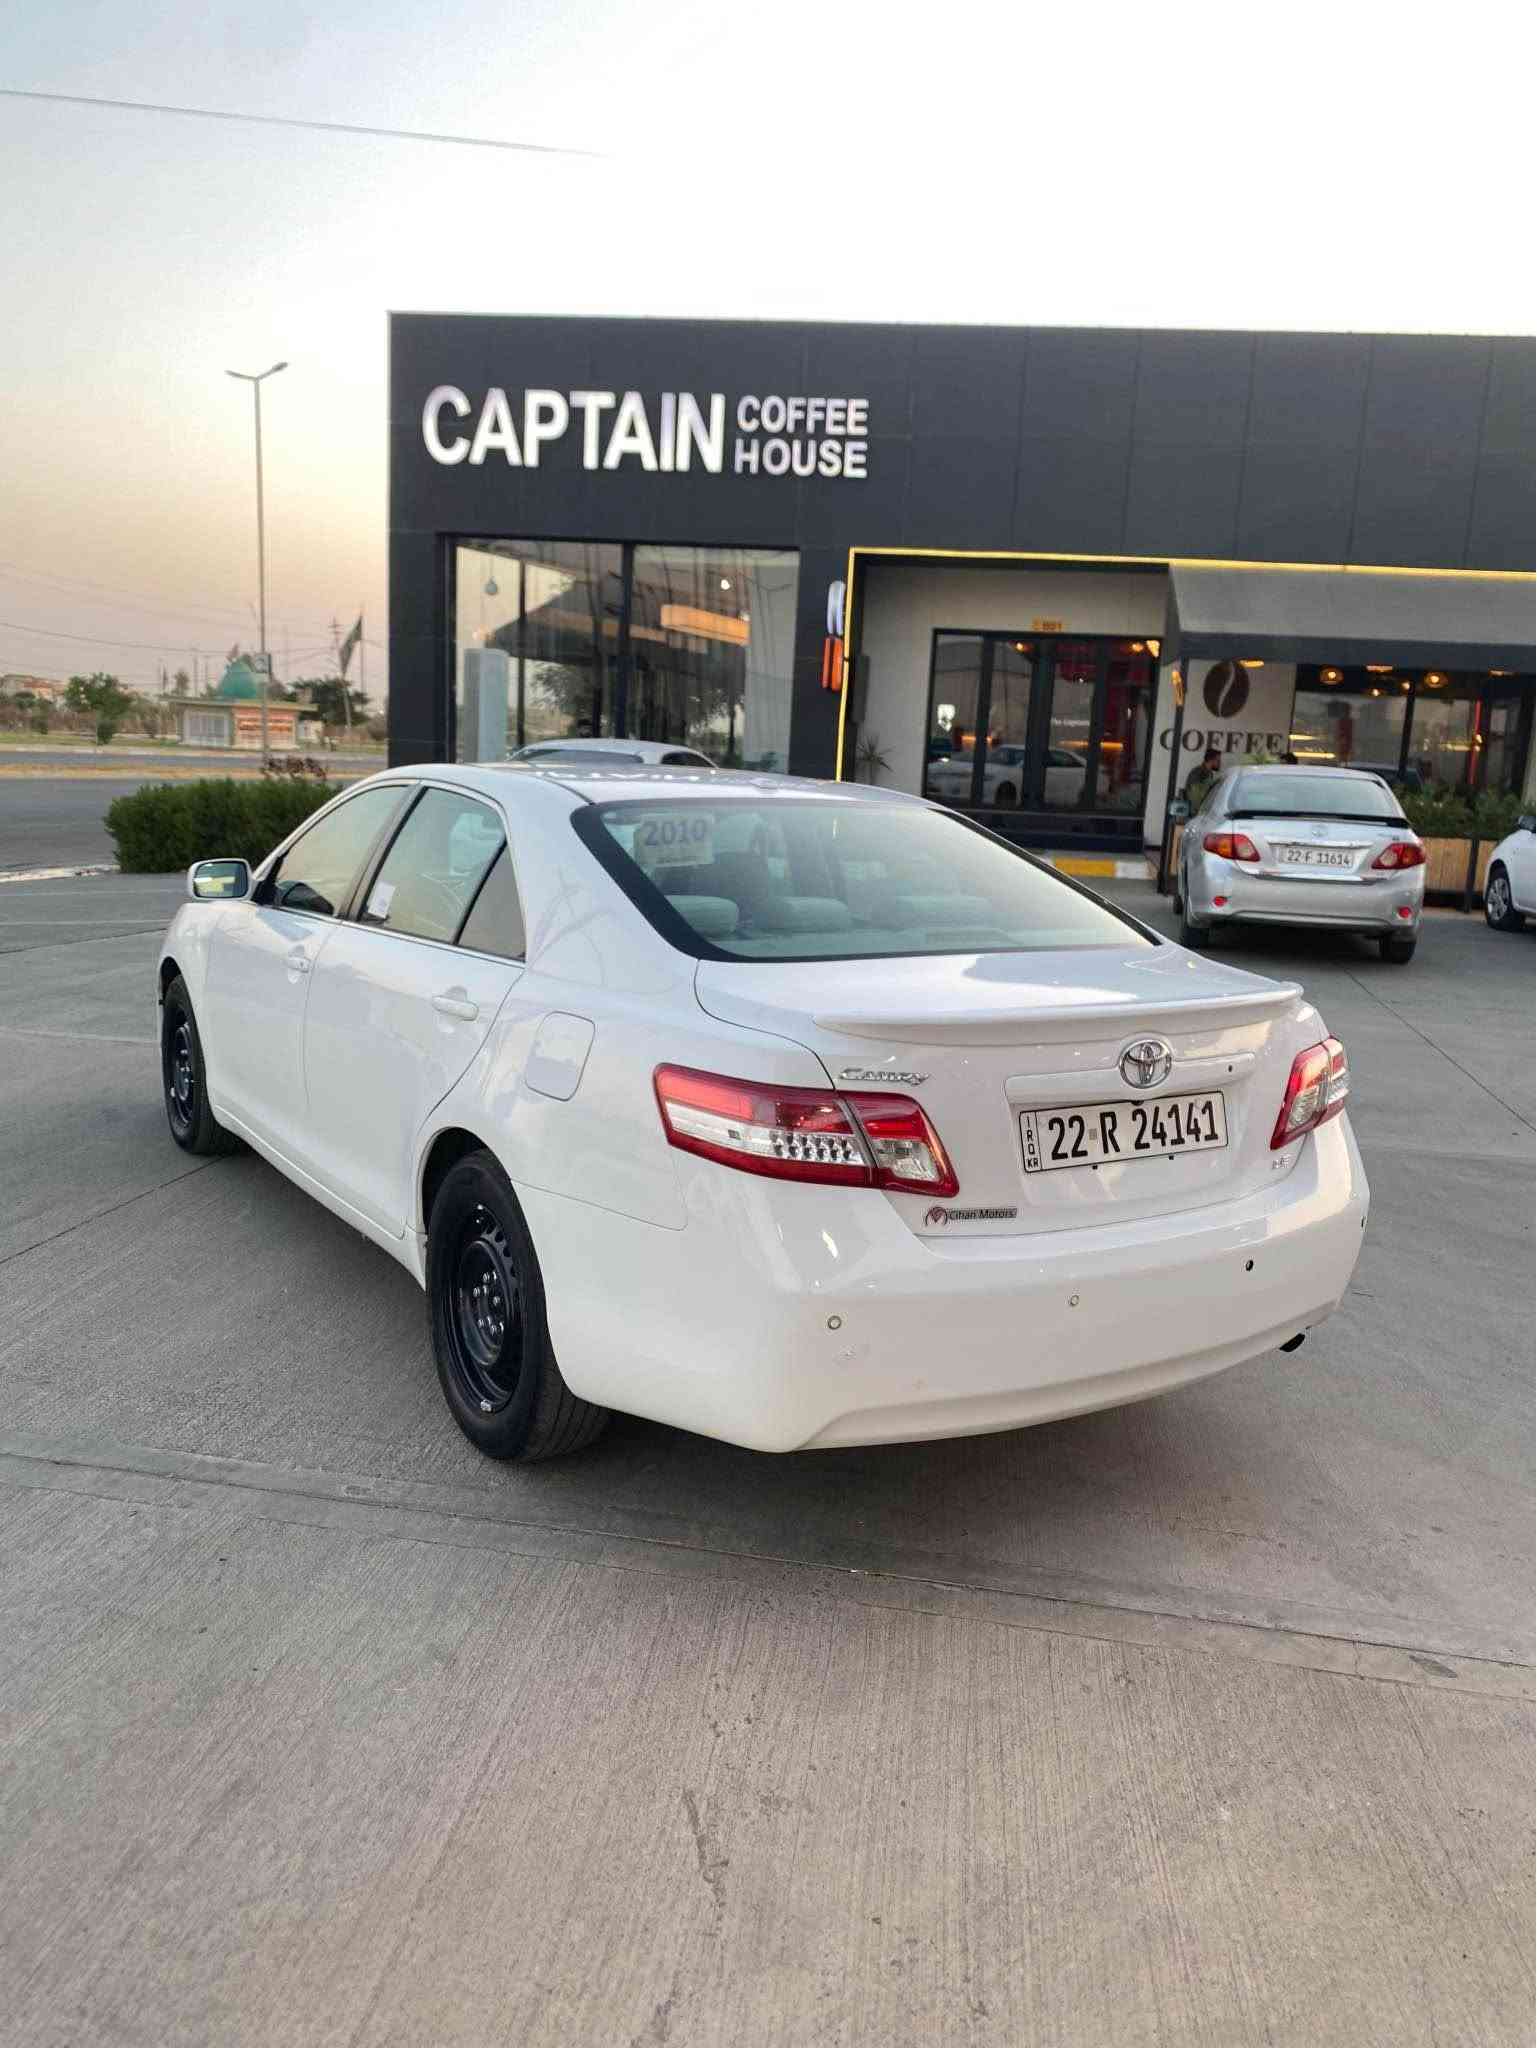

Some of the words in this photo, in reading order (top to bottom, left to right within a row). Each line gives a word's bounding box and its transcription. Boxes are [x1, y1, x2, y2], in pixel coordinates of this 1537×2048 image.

[422, 384, 726, 473] CAPTAIN
[736, 395, 869, 436] COFFEE
[734, 438, 868, 478] HOUSE
[1160, 727, 1285, 756] COFFEE
[643, 817, 709, 847] 2010
[1287, 849, 1301, 864] 22
[1317, 852, 1351, 866] 11614
[1048, 1115, 1088, 1161] 22
[1099, 1111, 1120, 1154] R
[1131, 1100, 1219, 1150] 24141
